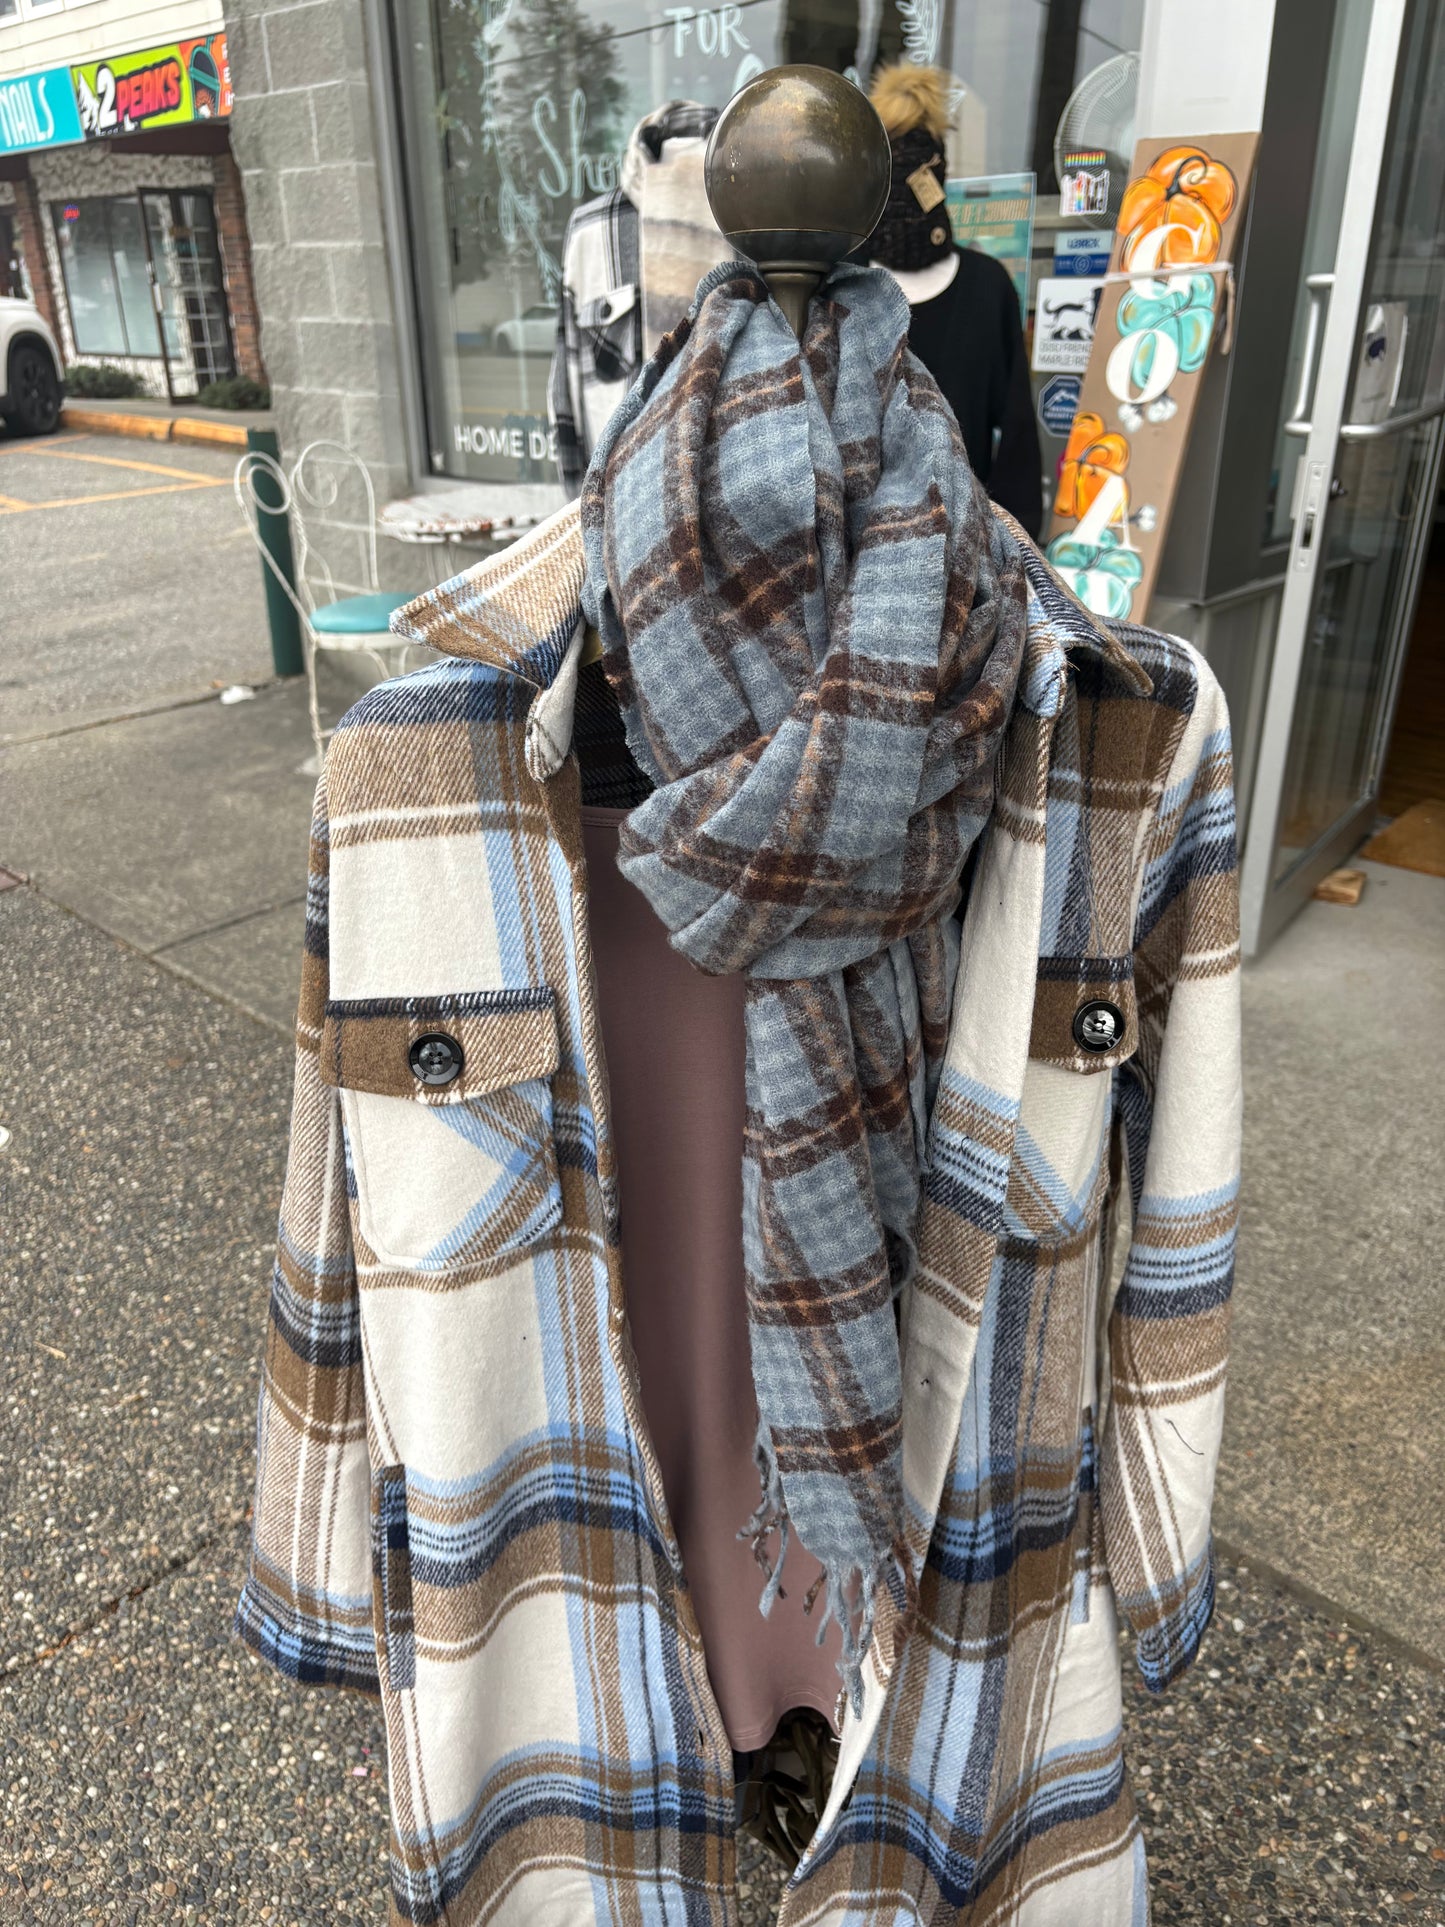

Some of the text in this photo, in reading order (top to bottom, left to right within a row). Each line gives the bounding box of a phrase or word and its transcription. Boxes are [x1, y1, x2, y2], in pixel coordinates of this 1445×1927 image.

[662, 3, 752, 59] FOR
[0, 76, 55, 148] NAILS
[96, 65, 118, 130] 2
[116, 61, 181, 123] PEAKS
[453, 424, 525, 459] HOME
